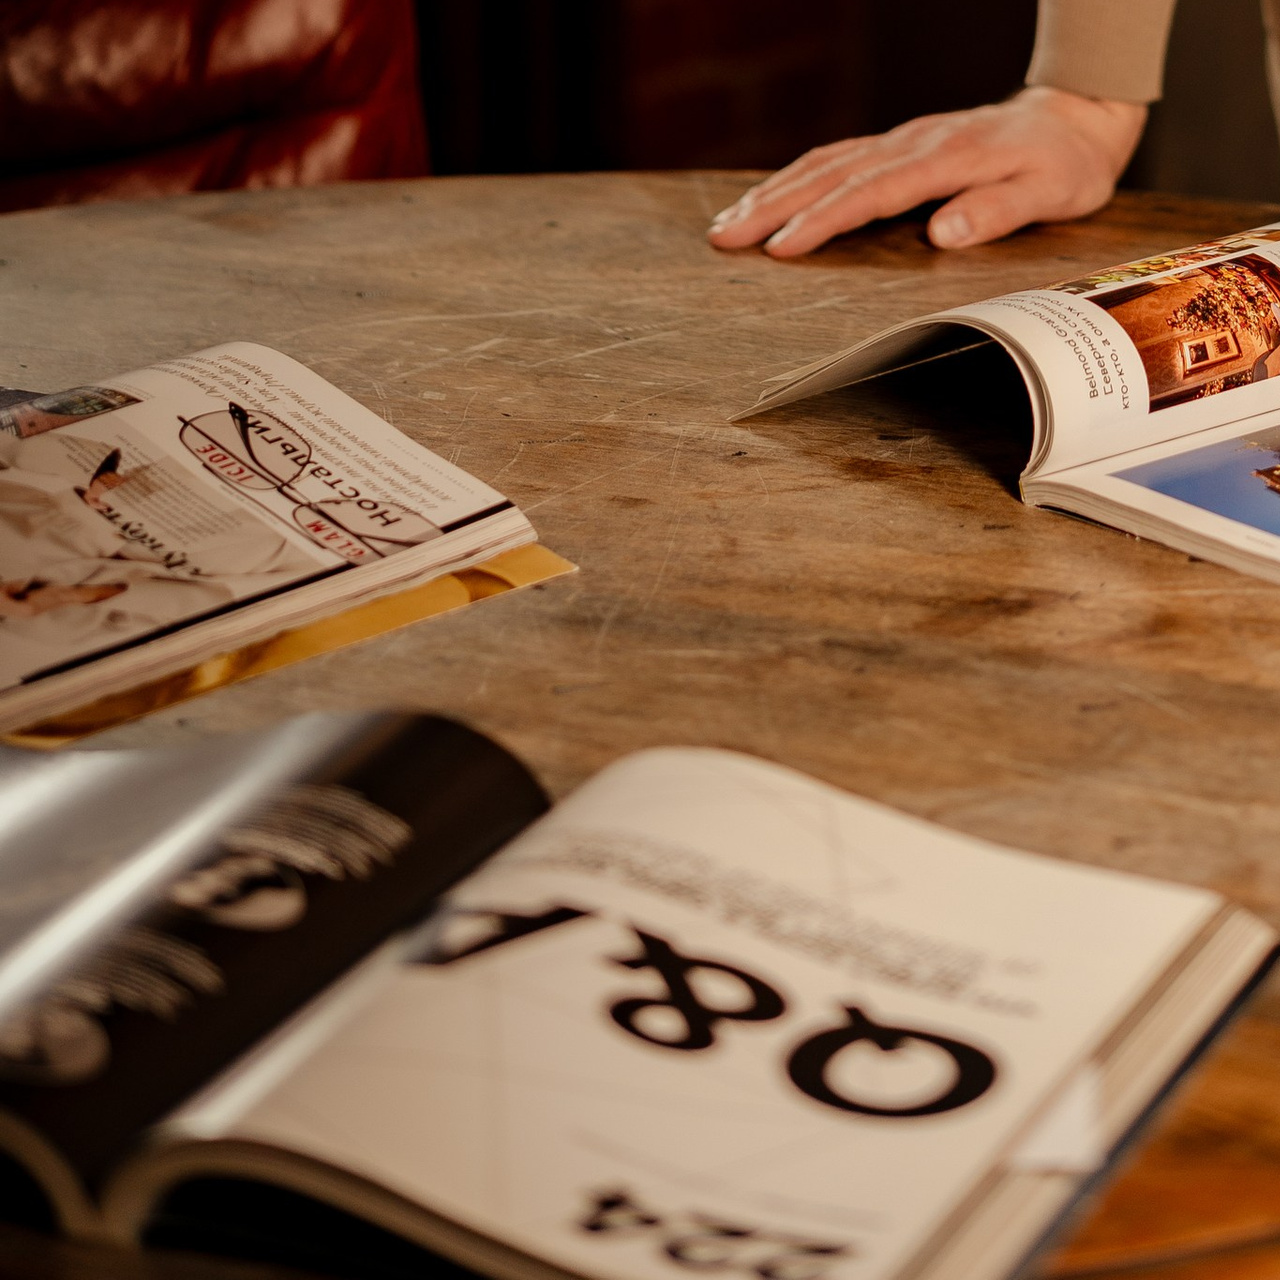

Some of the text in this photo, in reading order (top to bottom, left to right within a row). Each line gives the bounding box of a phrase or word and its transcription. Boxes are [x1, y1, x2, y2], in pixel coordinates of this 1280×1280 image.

[1030, 310, 1068, 339] Grand
[1081, 316, 1104, 337] они
[1065, 338, 1099, 399] Belmond
[1075, 329, 1114, 395] Северной
[194, 443, 256, 483] ICIDE
[305, 518, 366, 560] GLAM
